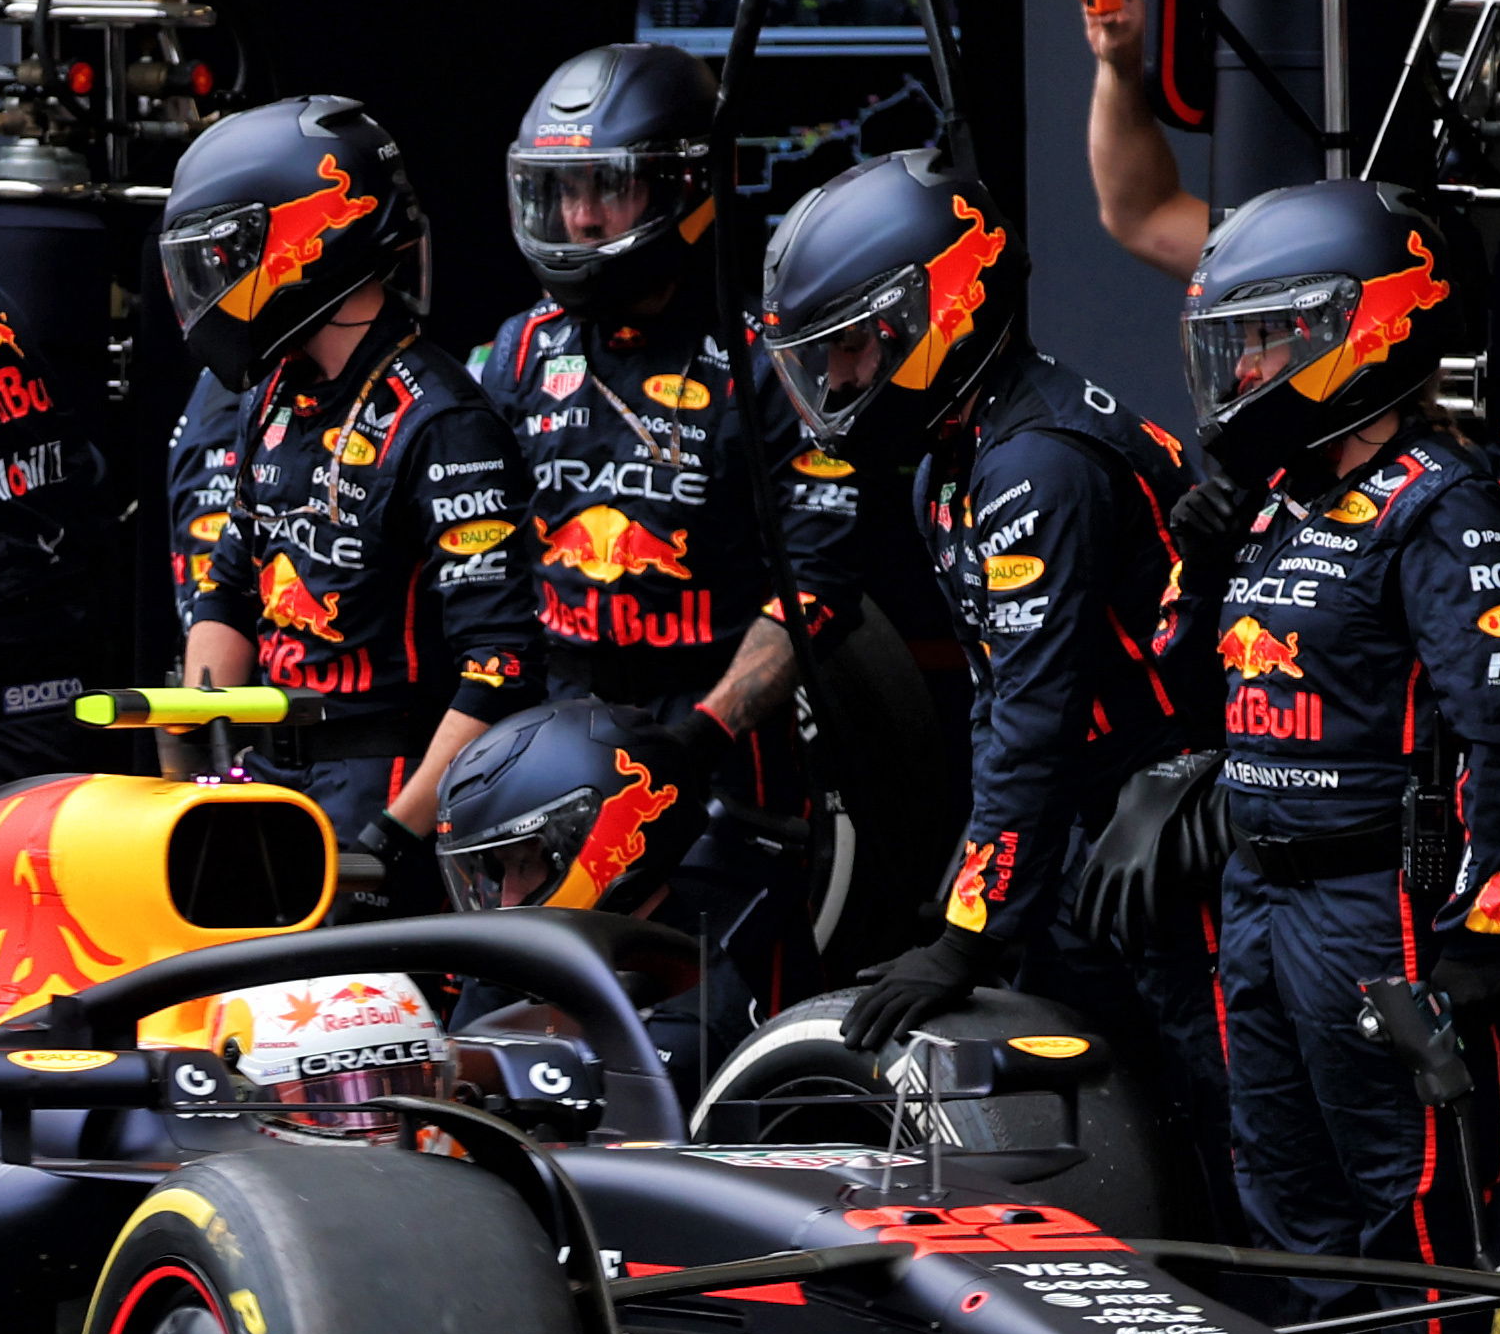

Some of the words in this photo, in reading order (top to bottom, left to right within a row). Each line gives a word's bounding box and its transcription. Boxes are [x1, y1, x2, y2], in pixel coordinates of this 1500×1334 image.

[537, 123, 594, 137] ORACLE
[208, 473, 237, 490] AV
[431, 488, 508, 524] ROKT
[460, 527, 508, 545] RAUCH
[1300, 526, 1359, 552] Gate.io
[988, 562, 1035, 580] RAUCH
[1277, 557, 1347, 579] HONDA
[609, 589, 713, 647] Bull
[269, 634, 373, 694] Bull
[5, 677, 84, 711] sparco
[1248, 687, 1323, 742] Bull
[1236, 762, 1340, 789] TENNYSON
[995, 830, 1018, 868] Bull
[988, 867, 1009, 902] Red
[321, 1009, 364, 1033] Red
[366, 1005, 401, 1027] Bull
[301, 1041, 428, 1076] ORACLE
[993, 1262, 1129, 1277] VISA
[1095, 1294, 1175, 1305] AT&T
